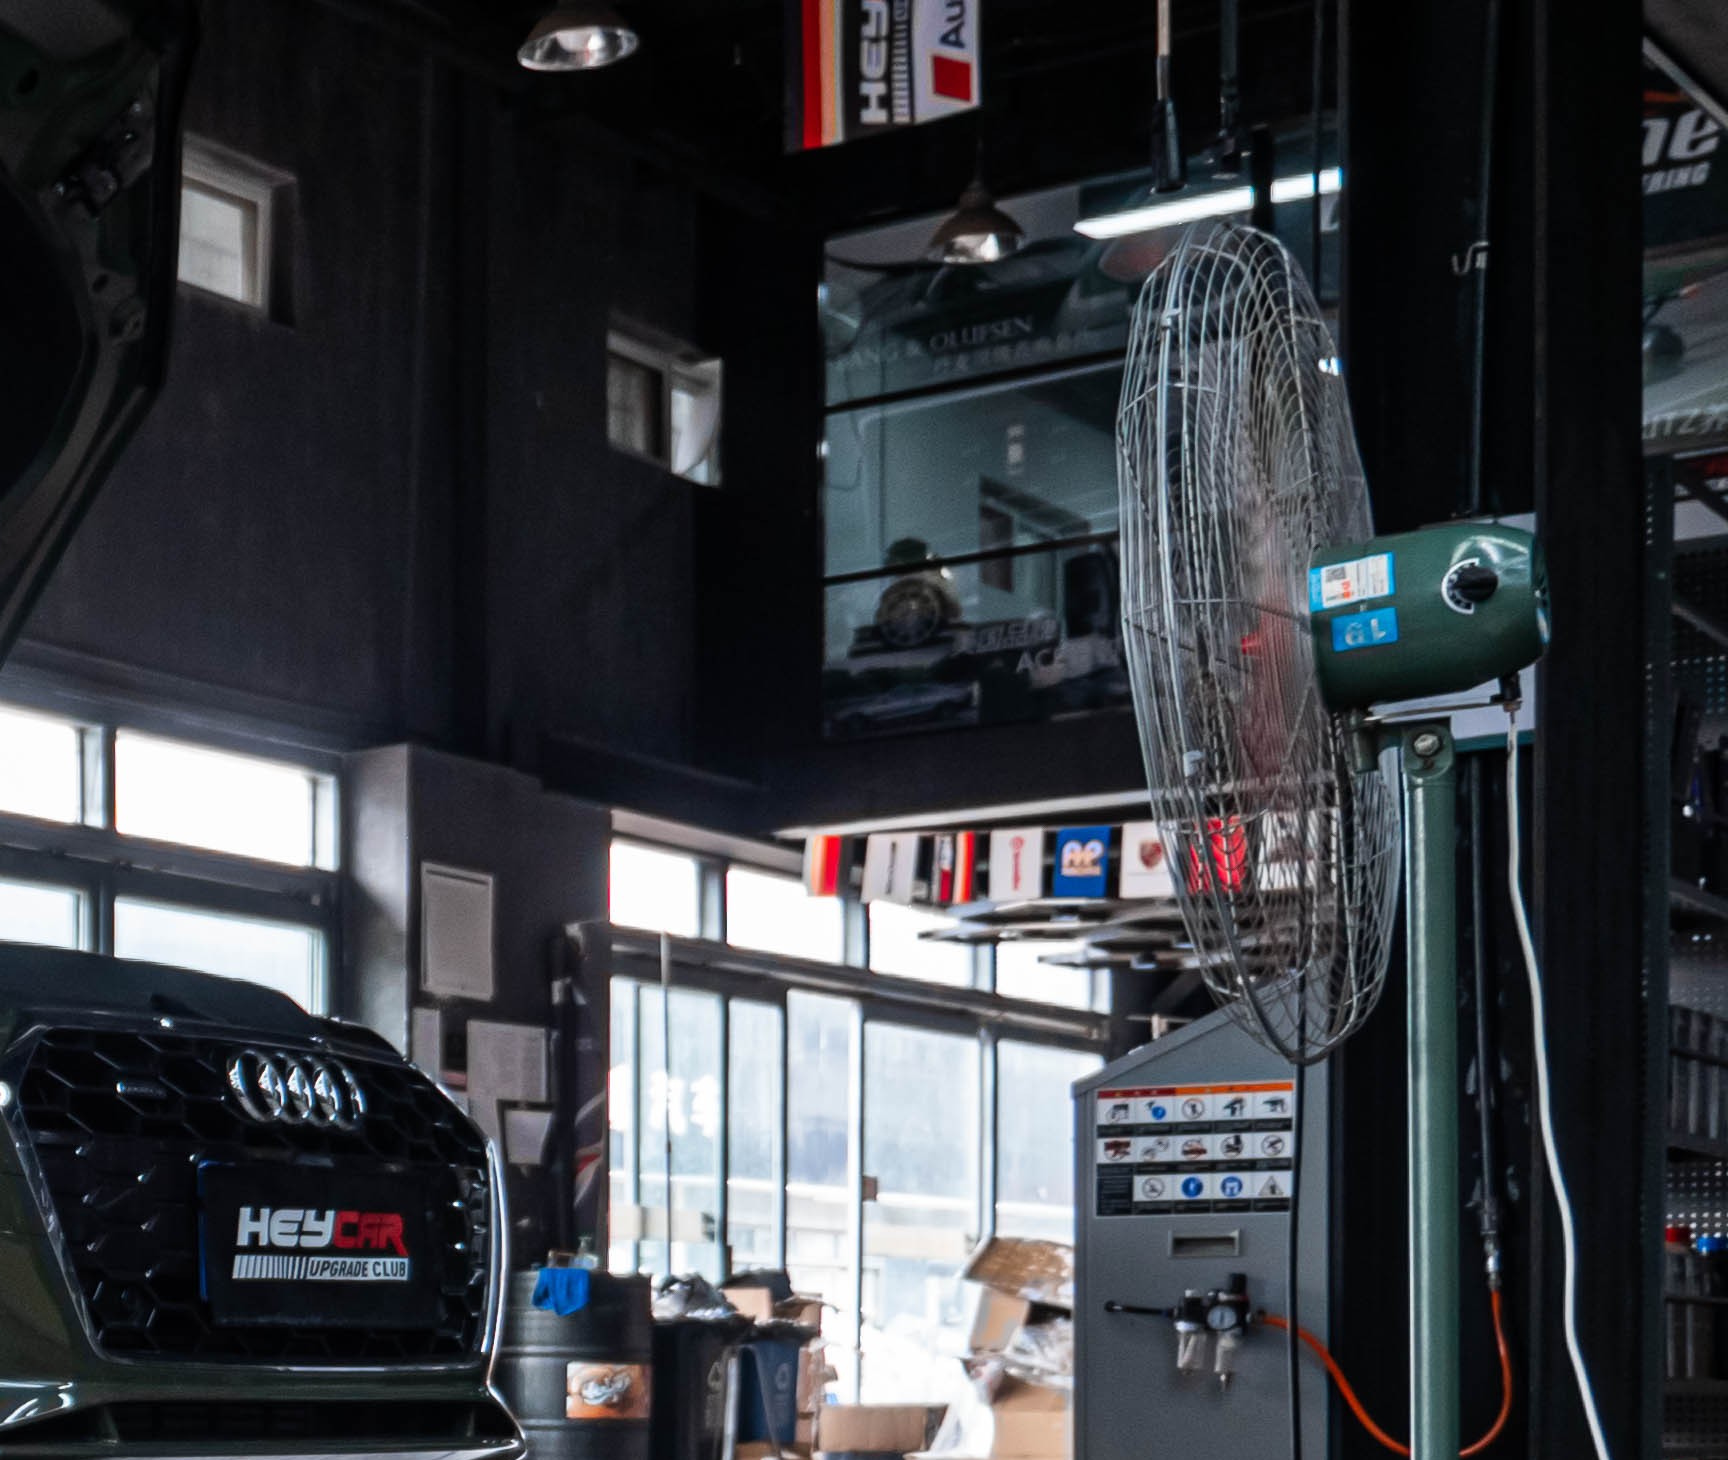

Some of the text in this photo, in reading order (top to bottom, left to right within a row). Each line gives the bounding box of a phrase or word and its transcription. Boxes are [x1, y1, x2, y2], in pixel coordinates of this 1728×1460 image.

[236, 1206, 409, 1257] HEYCAR
[309, 1260, 407, 1278] UPGRADE CLUB
